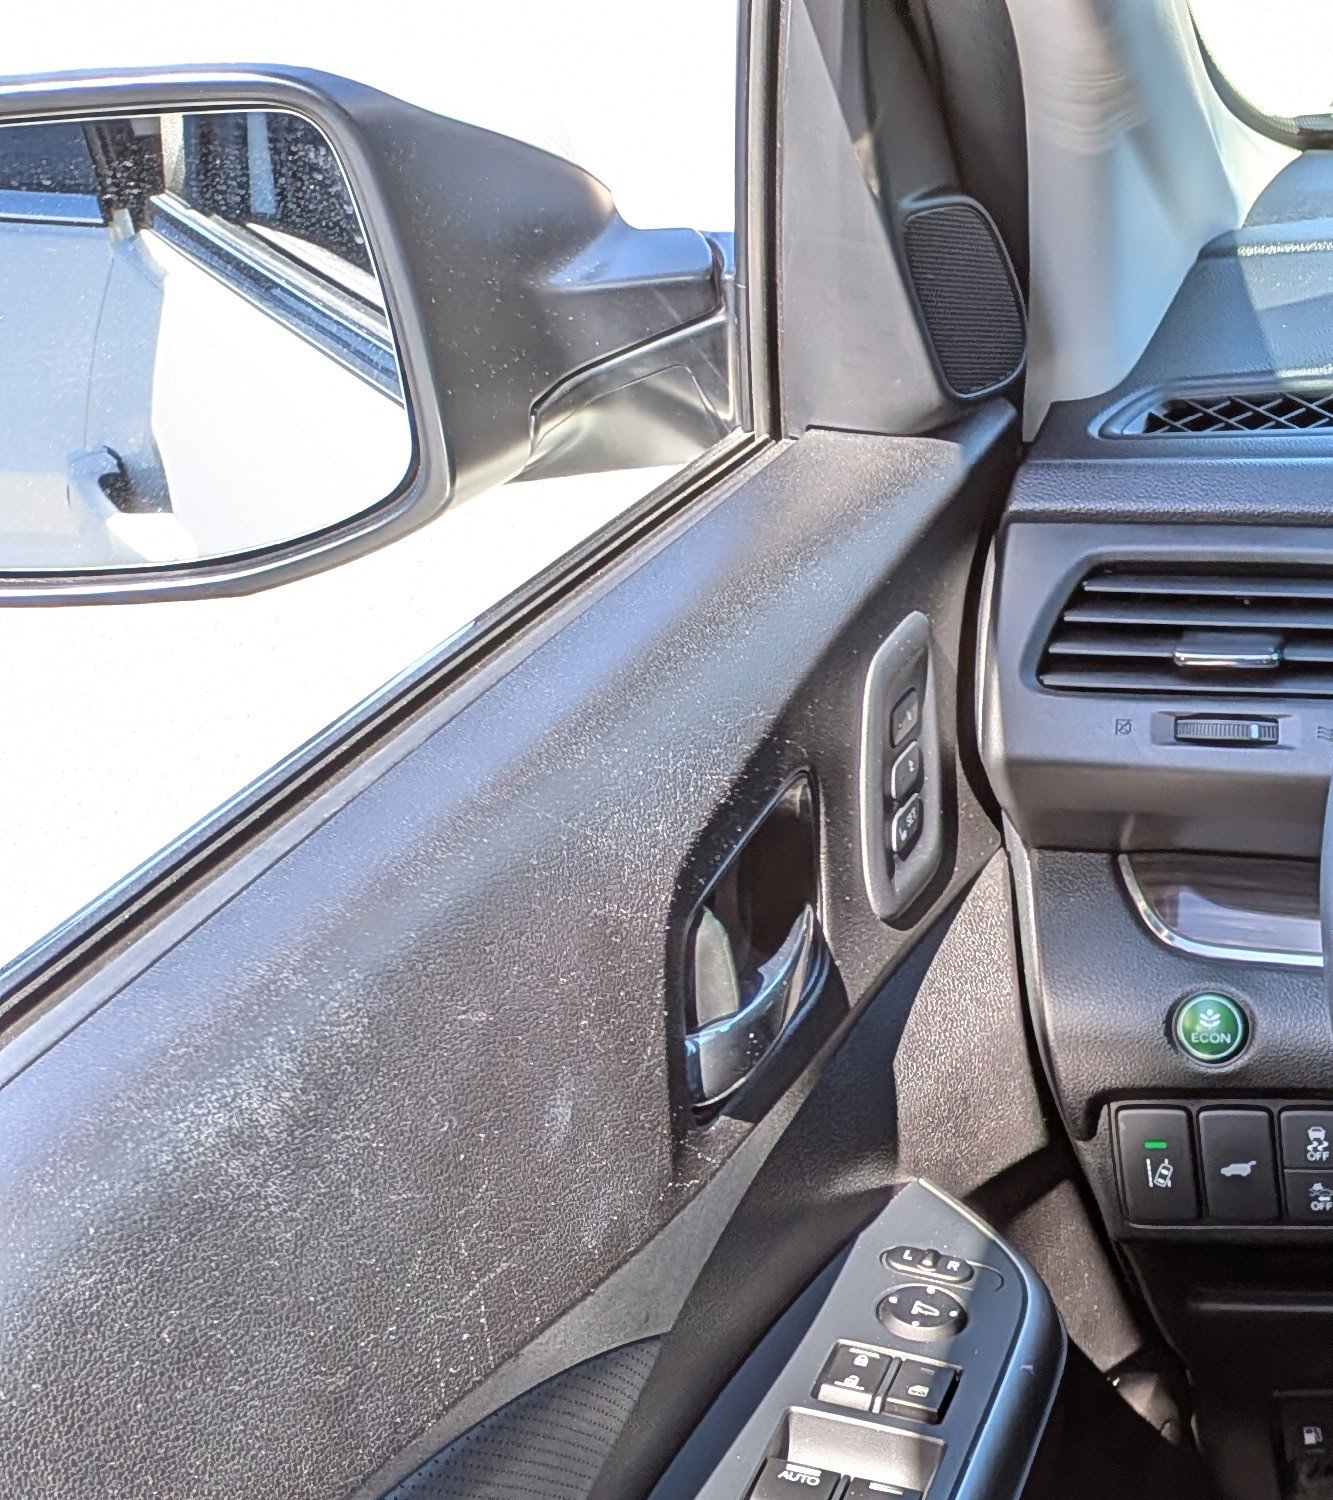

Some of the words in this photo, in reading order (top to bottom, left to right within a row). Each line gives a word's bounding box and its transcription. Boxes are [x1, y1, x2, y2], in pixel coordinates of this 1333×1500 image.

[1191, 1032, 1231, 1044] ECON
[1307, 1152, 1330, 1161] OFF
[1310, 1201, 1333, 1211] OFF
[902, 1250, 912, 1261] L
[947, 1260, 960, 1271] R
[778, 1469, 820, 1487] AUTO
